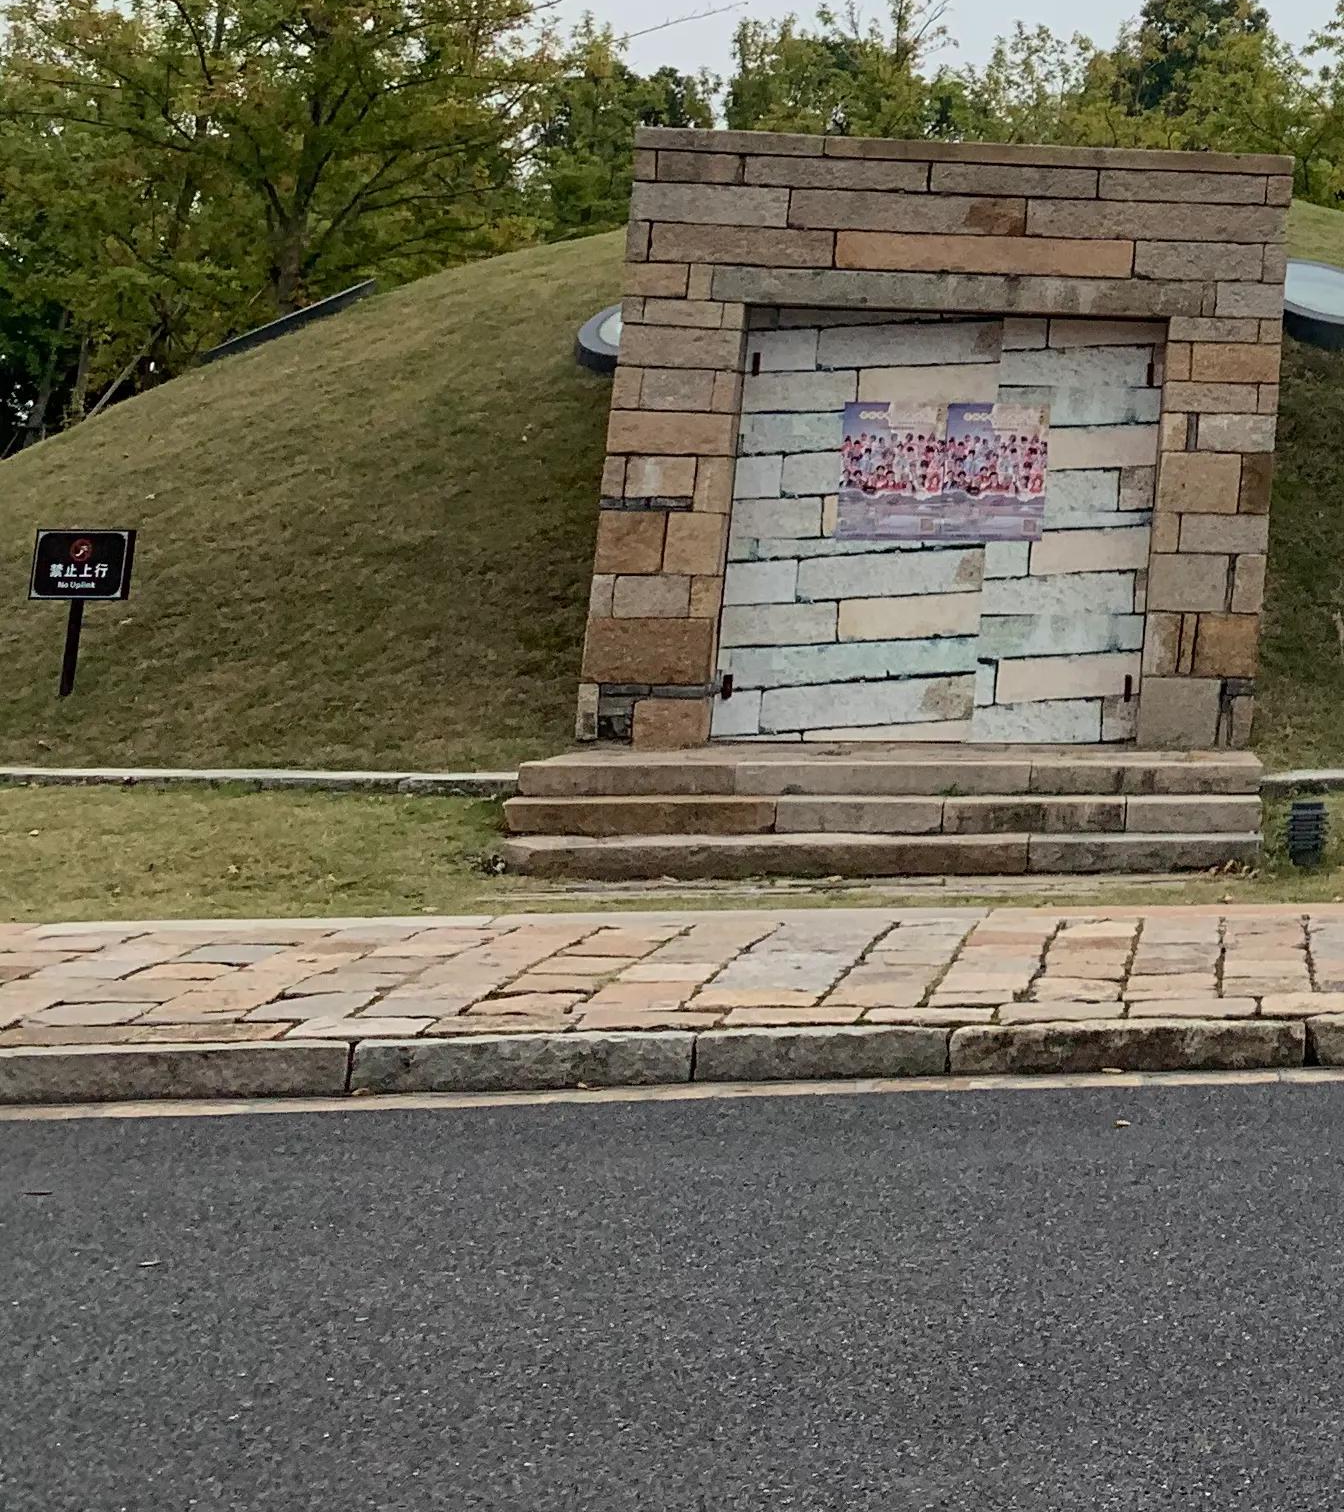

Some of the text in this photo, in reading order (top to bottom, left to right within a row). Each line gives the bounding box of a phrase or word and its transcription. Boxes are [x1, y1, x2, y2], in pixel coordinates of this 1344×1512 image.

[50, 563, 108, 578] 禁止上行
[57, 581, 69, 589] No
